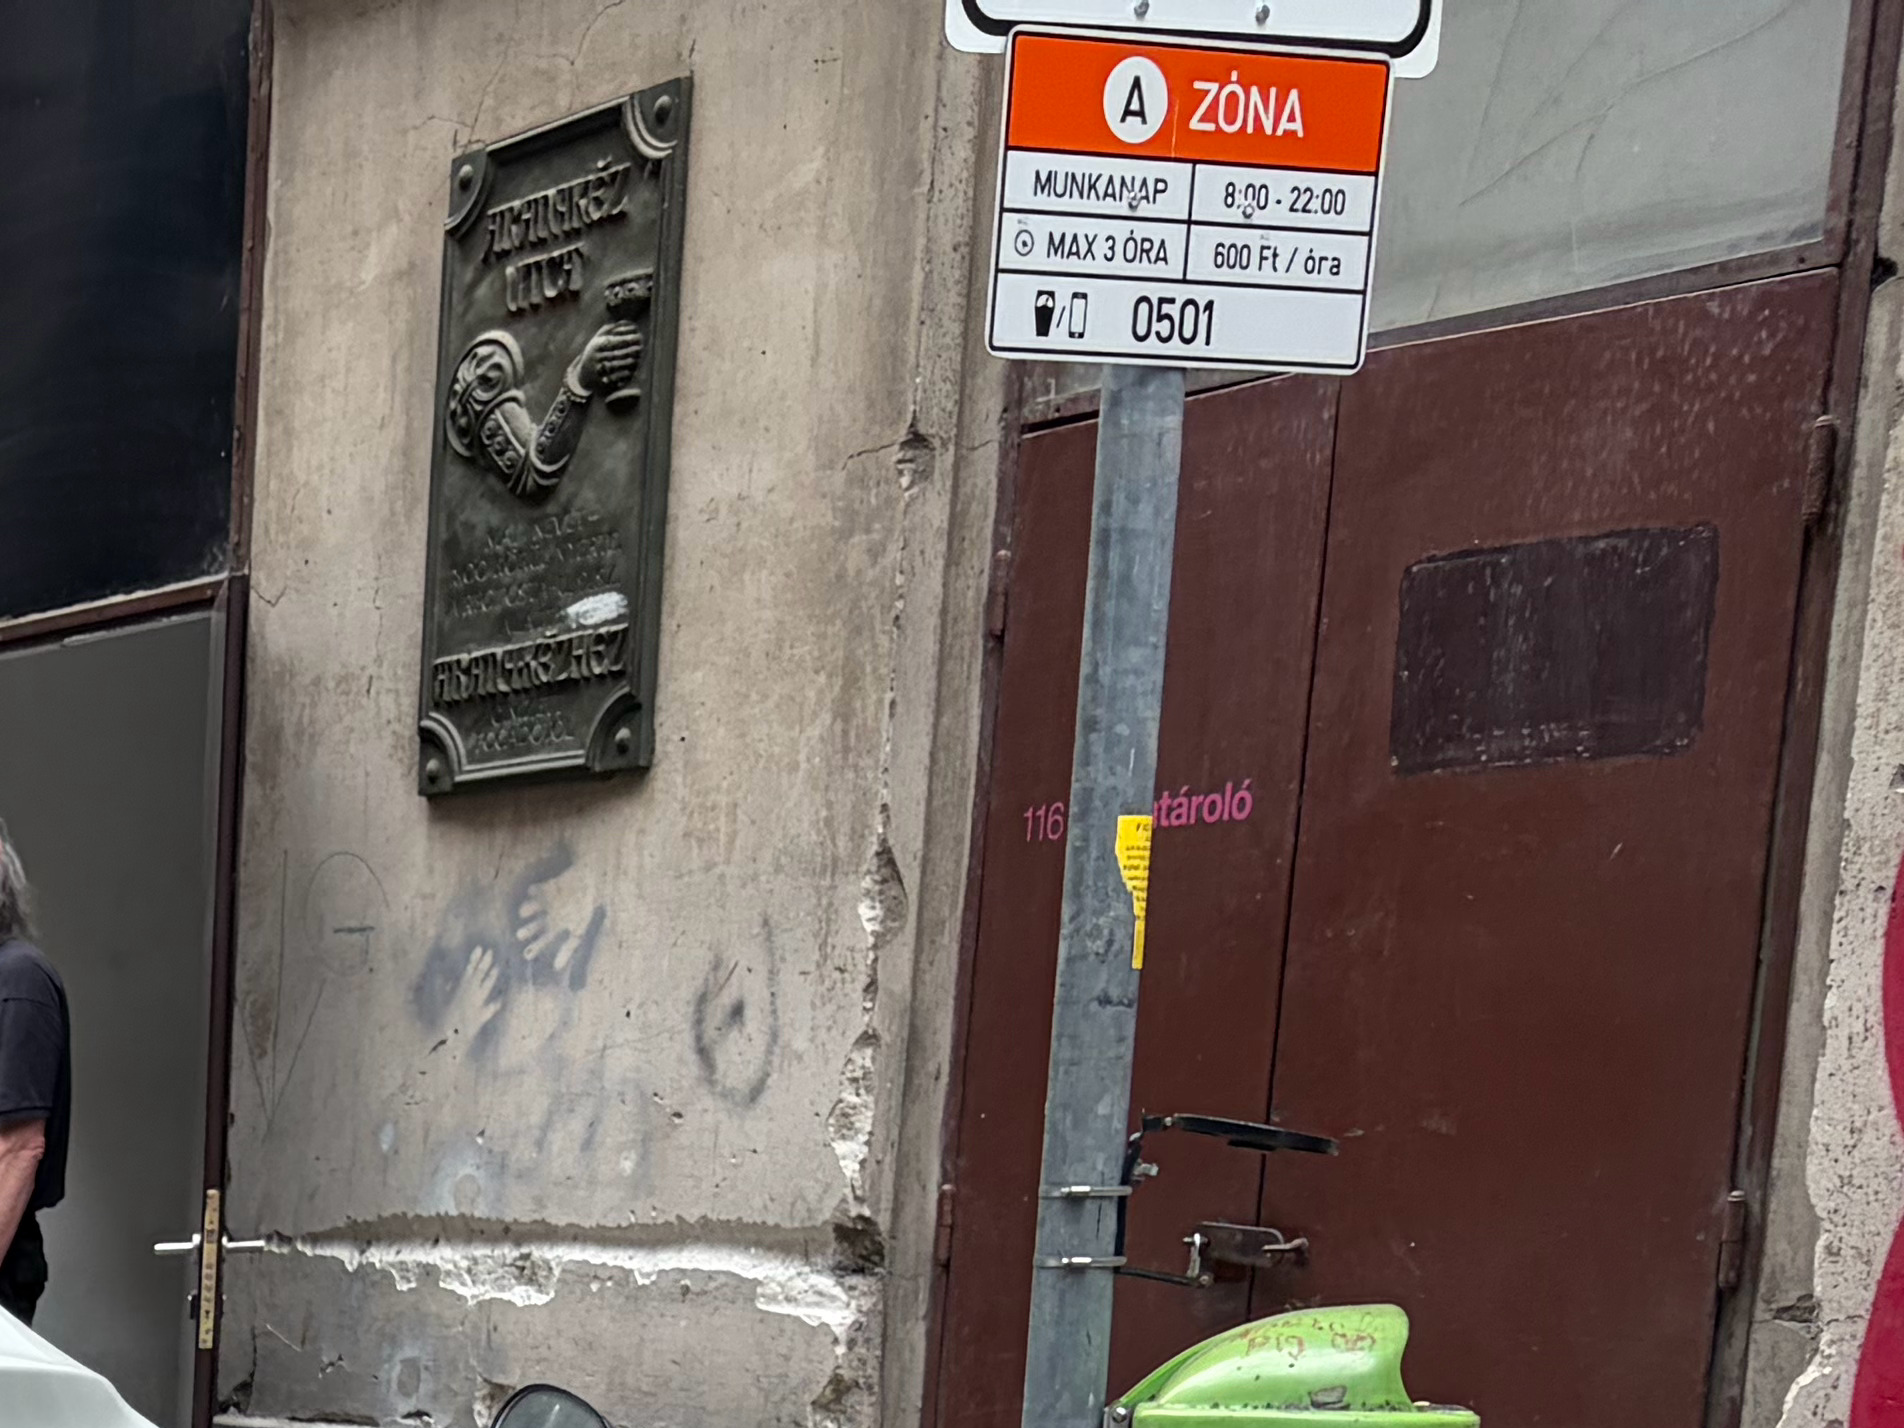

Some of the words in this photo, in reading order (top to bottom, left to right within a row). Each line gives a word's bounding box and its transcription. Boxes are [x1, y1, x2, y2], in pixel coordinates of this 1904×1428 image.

[1120, 75, 1149, 126] A
[1189, 70, 1305, 138] ZÓNA
[1033, 169, 1169, 206] MUNKANAP
[1223, 182, 1270, 212] 8:00
[1289, 185, 1347, 216] 22:00
[1046, 231, 1098, 263] MAX
[1103, 235, 1116, 263] 3
[1123, 228, 1170, 267] ÓRA
[1213, 244, 1252, 272] 600
[1257, 246, 1281, 274] Ft
[1303, 247, 1342, 276] óra
[1130, 294, 1217, 347] 0501
[1023, 801, 1066, 843] 116
